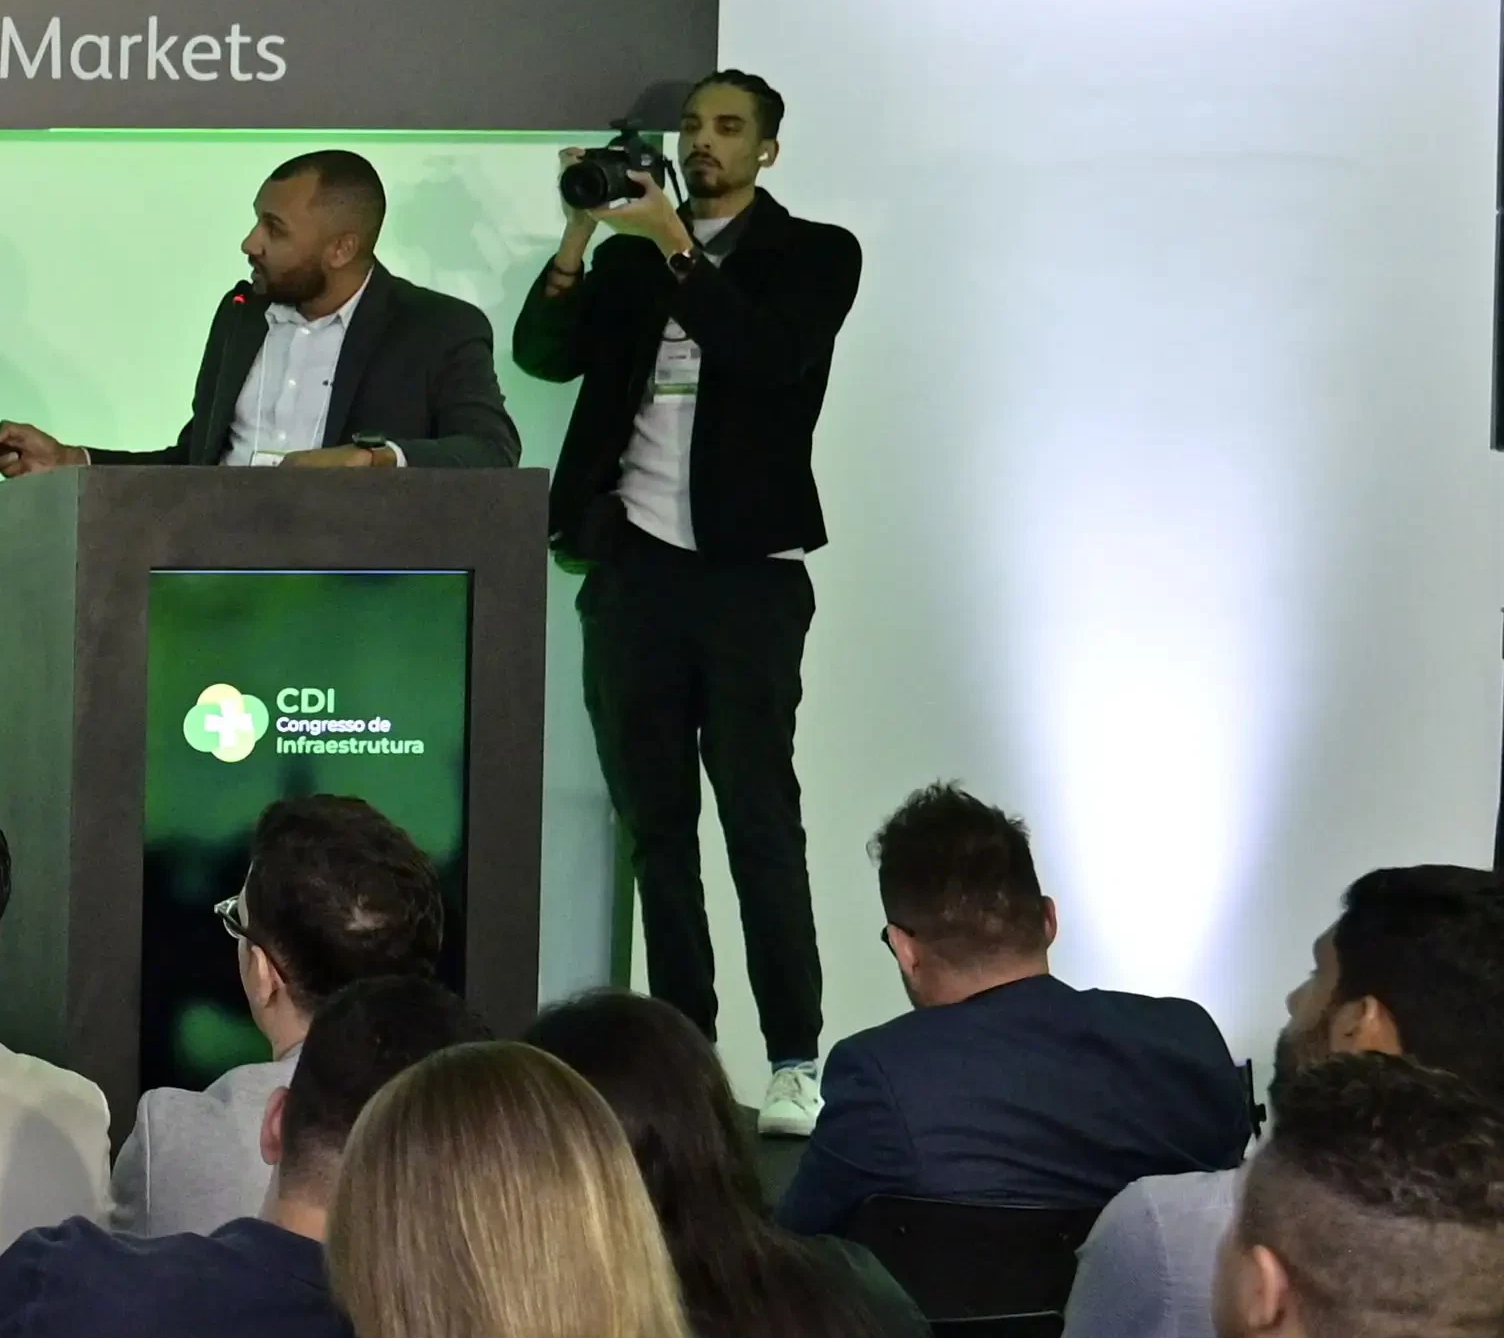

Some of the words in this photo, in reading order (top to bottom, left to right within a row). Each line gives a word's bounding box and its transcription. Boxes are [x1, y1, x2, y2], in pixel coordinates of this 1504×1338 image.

[0, 14, 288, 83] Markets
[276, 687, 335, 714] CDI
[276, 716, 365, 736] Congresso
[368, 716, 392, 733] de
[276, 736, 425, 755] Infraestrutura
